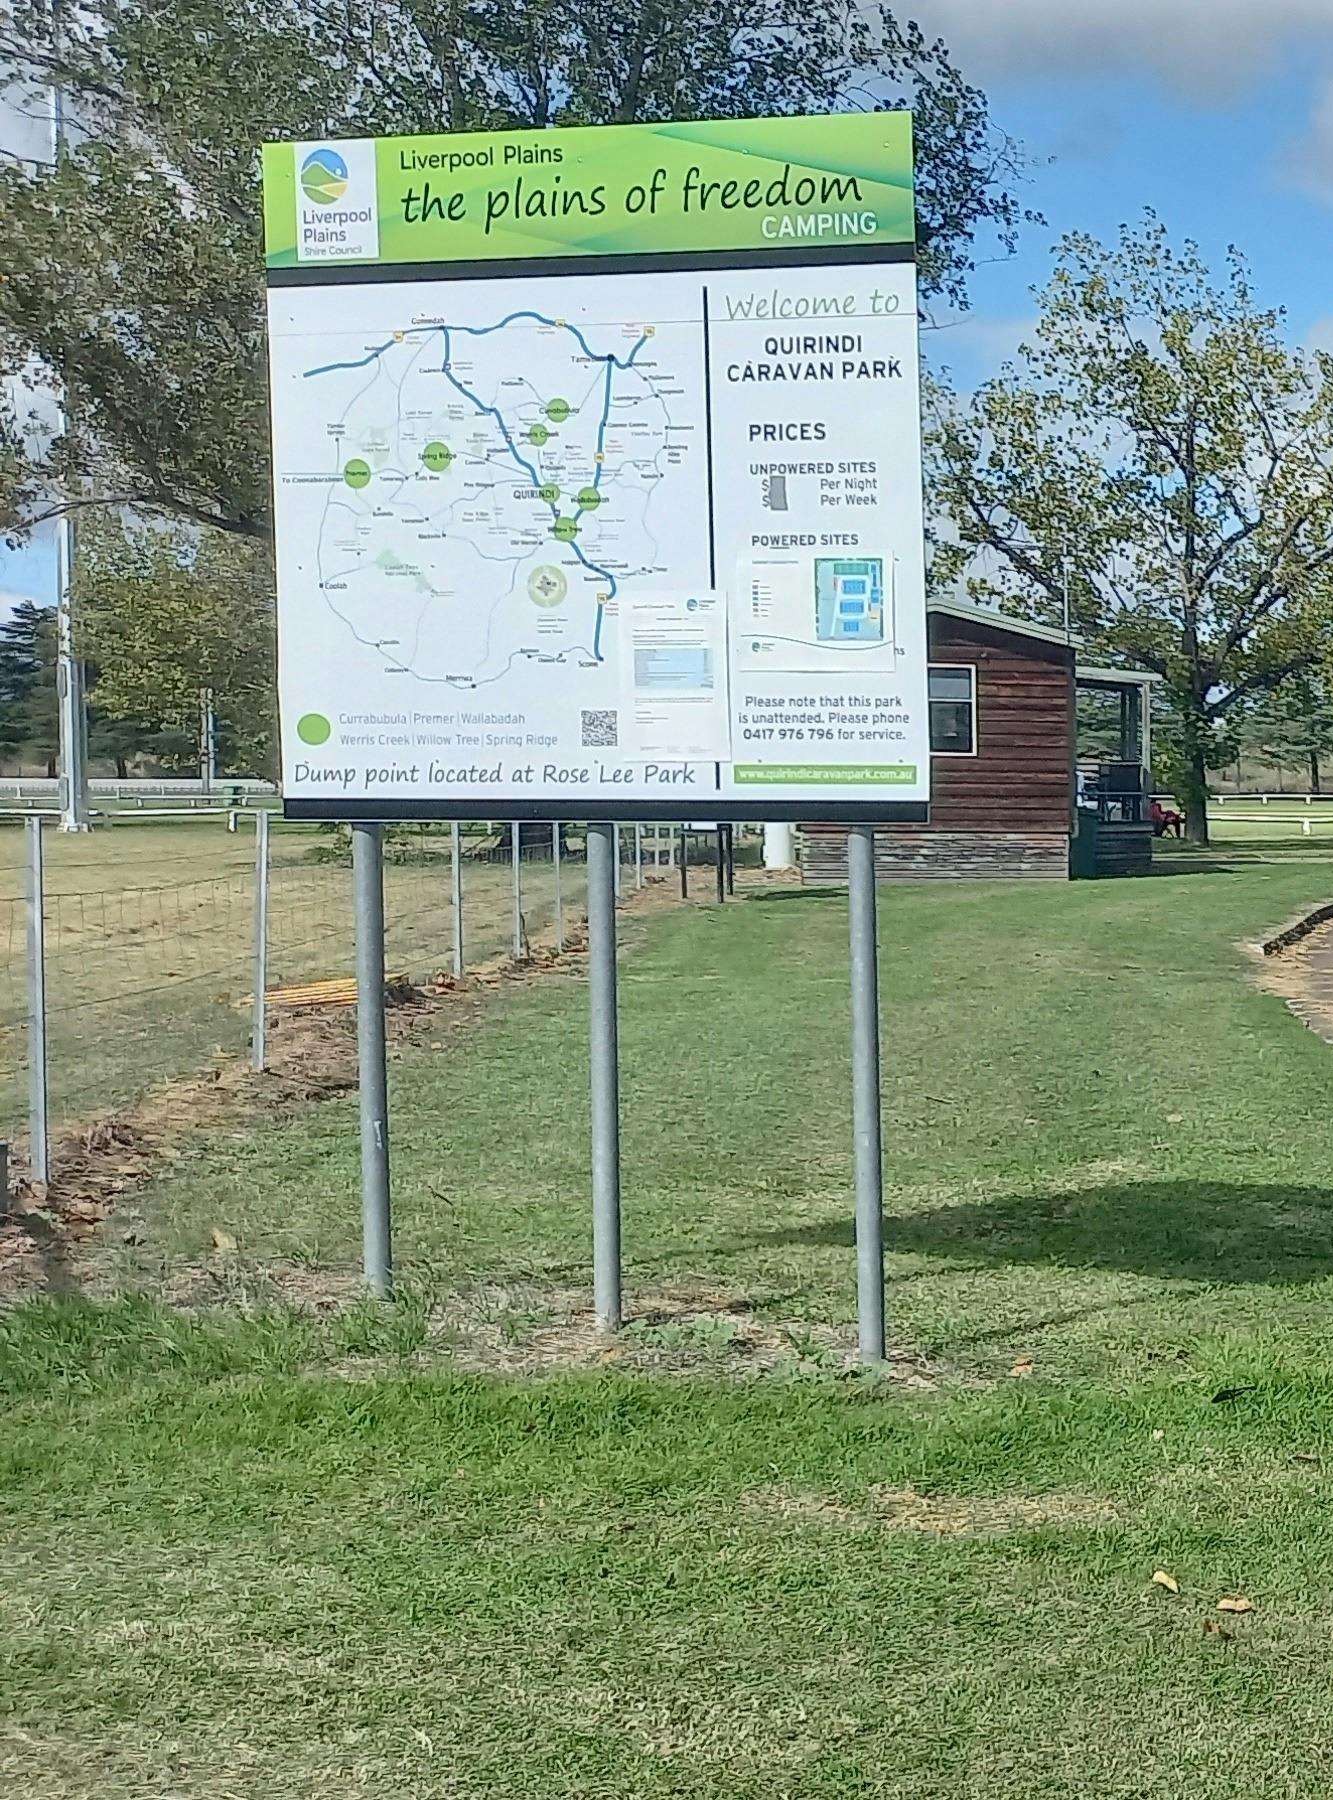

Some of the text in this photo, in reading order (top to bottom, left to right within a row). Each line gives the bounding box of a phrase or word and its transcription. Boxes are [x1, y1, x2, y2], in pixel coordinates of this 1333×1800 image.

[400, 144, 563, 172] Liverpool Plains
[401, 163, 862, 234] the plains of freedom
[303, 208, 372, 226] Liverpool
[761, 211, 877, 239] CAMPING
[303, 228, 347, 243] Plains
[304, 244, 362, 256] Shire Council
[726, 289, 899, 320] Welcome to
[765, 335, 862, 355] QUIRINDI
[727, 359, 903, 382] CARAVAN PARK
[749, 423, 826, 441] PRICES
[750, 462, 877, 475] UNPOWERED SITES
[820, 479, 841, 490] Per
[844, 478, 877, 491] Night
[820, 495, 841, 506] Per
[844, 494, 877, 505] Week
[751, 534, 859, 547] POWERED SITES
[745, 696, 902, 710] Please note that this park
[339, 713, 525, 725] Currabubula Premer Wallabadah
[739, 712, 910, 727] is unattended. Please phone
[340, 734, 558, 748] Werris Creek Willow Tree Spring Ridge
[743, 728, 906, 740] 0417 976 796 for service.
[294, 762, 695, 790] Dump point located at Rose Lee Park
[739, 768, 912, 781] www.quirindicaravanpark.com.au
